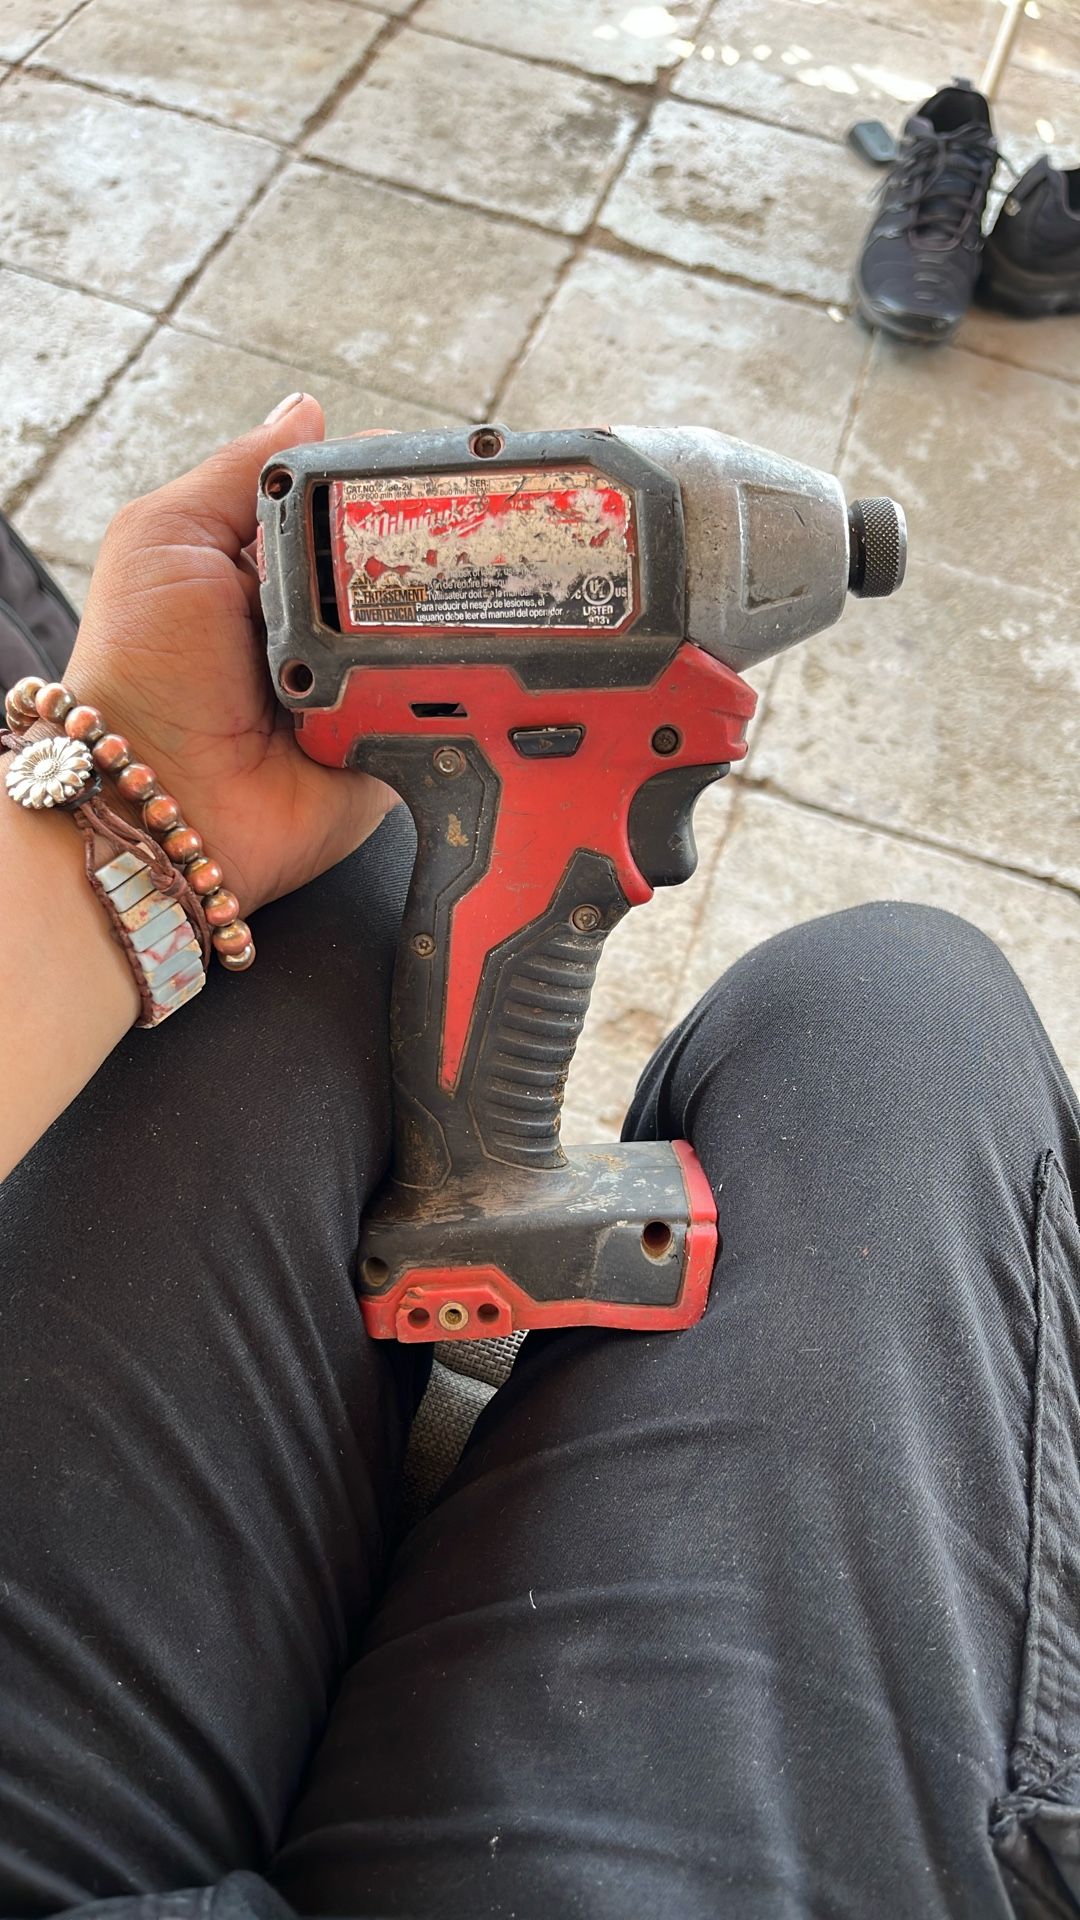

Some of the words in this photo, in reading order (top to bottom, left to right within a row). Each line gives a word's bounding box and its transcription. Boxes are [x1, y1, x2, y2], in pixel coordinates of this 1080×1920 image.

[469, 479, 489, 488] SER.
[614, 586, 628, 598] US
[416, 602, 434, 612] Para
[435, 601, 460, 611] reducir
[461, 600, 469, 610] el
[493, 599, 503, 609] de
[503, 598, 537, 608] lesiones,
[537, 597, 545, 607] el
[355, 607, 413, 621] ADVERTENCIA
[416, 612, 445, 623] usuario
[445, 612, 464, 622] debe
[465, 611, 480, 621] leer
[480, 609, 488, 620] el
[488, 609, 515, 619] manual
[516, 608, 528, 618] del
